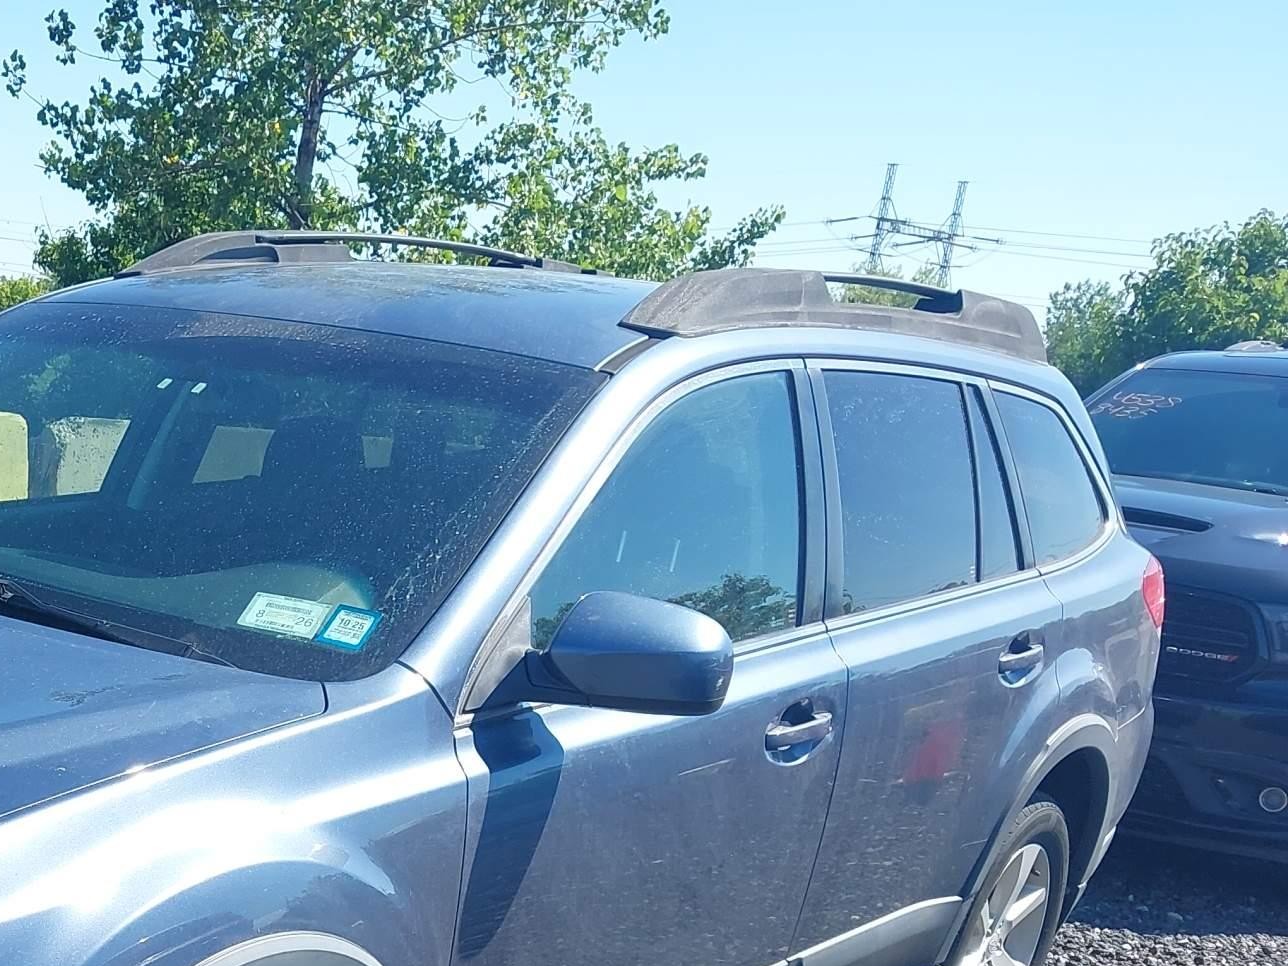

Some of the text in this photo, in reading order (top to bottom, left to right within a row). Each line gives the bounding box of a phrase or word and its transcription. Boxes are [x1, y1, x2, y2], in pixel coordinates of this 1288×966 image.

[255, 608, 266, 618] 8
[295, 616, 314, 628] 26
[1166, 646, 1229, 661] DODGE
